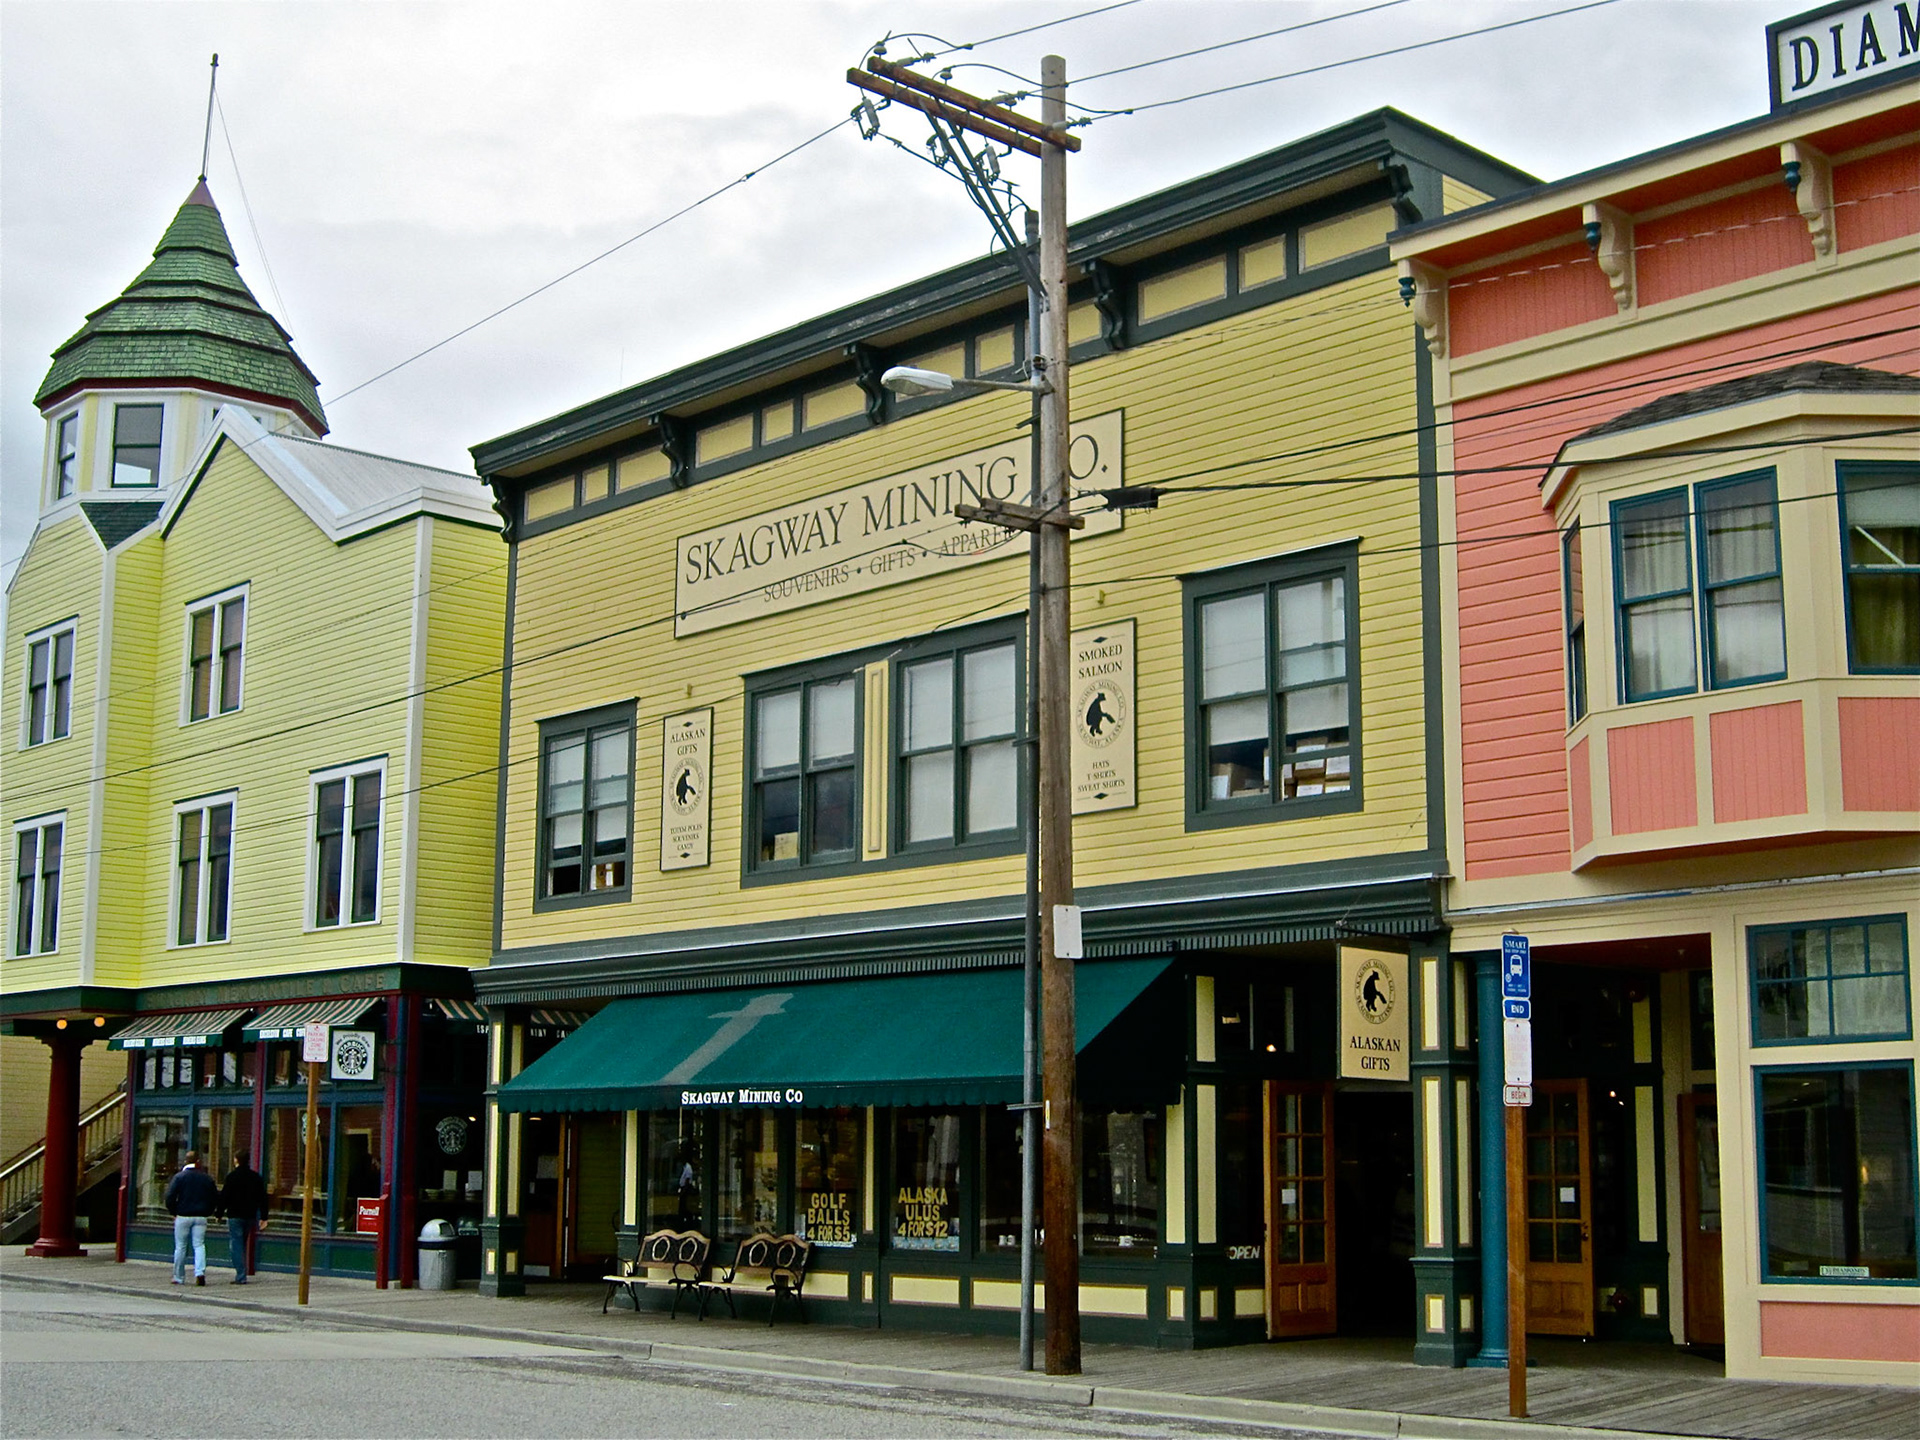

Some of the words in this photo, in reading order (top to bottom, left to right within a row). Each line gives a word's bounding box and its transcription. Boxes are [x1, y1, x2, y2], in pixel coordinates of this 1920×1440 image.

[1788, 0, 1920, 92] DIAM
[685, 501, 850, 585] SKAGWAY
[861, 456, 1018, 537] MINING
[1068, 433, 1109, 481] O.
[763, 564, 850, 603] SOUVENIRS
[869, 547, 916, 576] GIFTS
[1078, 644, 1123, 663] SMOKED
[1078, 661, 1123, 680] SALMON
[670, 728, 706, 743] ALASKAN
[676, 743, 698, 756] GIFTS
[1092, 760, 1110, 770] HATS
[1077, 782, 1101, 793] SWEAT
[1102, 778, 1126, 789] SHIRTS
[1504, 940, 1527, 949] SMART
[217, 978, 314, 1001] MERCANTILE
[339, 972, 385, 994] CAFE
[1511, 1004, 1525, 1014] END
[338, 1040, 368, 1060] STARBUCKS
[1349, 1035, 1401, 1052] ALASKAN
[340, 1062, 364, 1076] COFFEE
[1360, 1055, 1390, 1071] GIFTS
[1510, 1090, 1526, 1100] BEGIN
[811, 1192, 847, 1209] GOLF
[898, 1186, 949, 1205] ALASKA
[807, 1208, 850, 1226] BALLS
[905, 1204, 940, 1221] ULUS
[807, 1226, 815, 1240] 4
[817, 1226, 833, 1242] FOR
[834, 1225, 850, 1242] $5
[897, 1222, 906, 1237] 4
[907, 1221, 924, 1237] FOR
[925, 1220, 948, 1237] $12
[1228, 1245, 1261, 1260] OPEN
